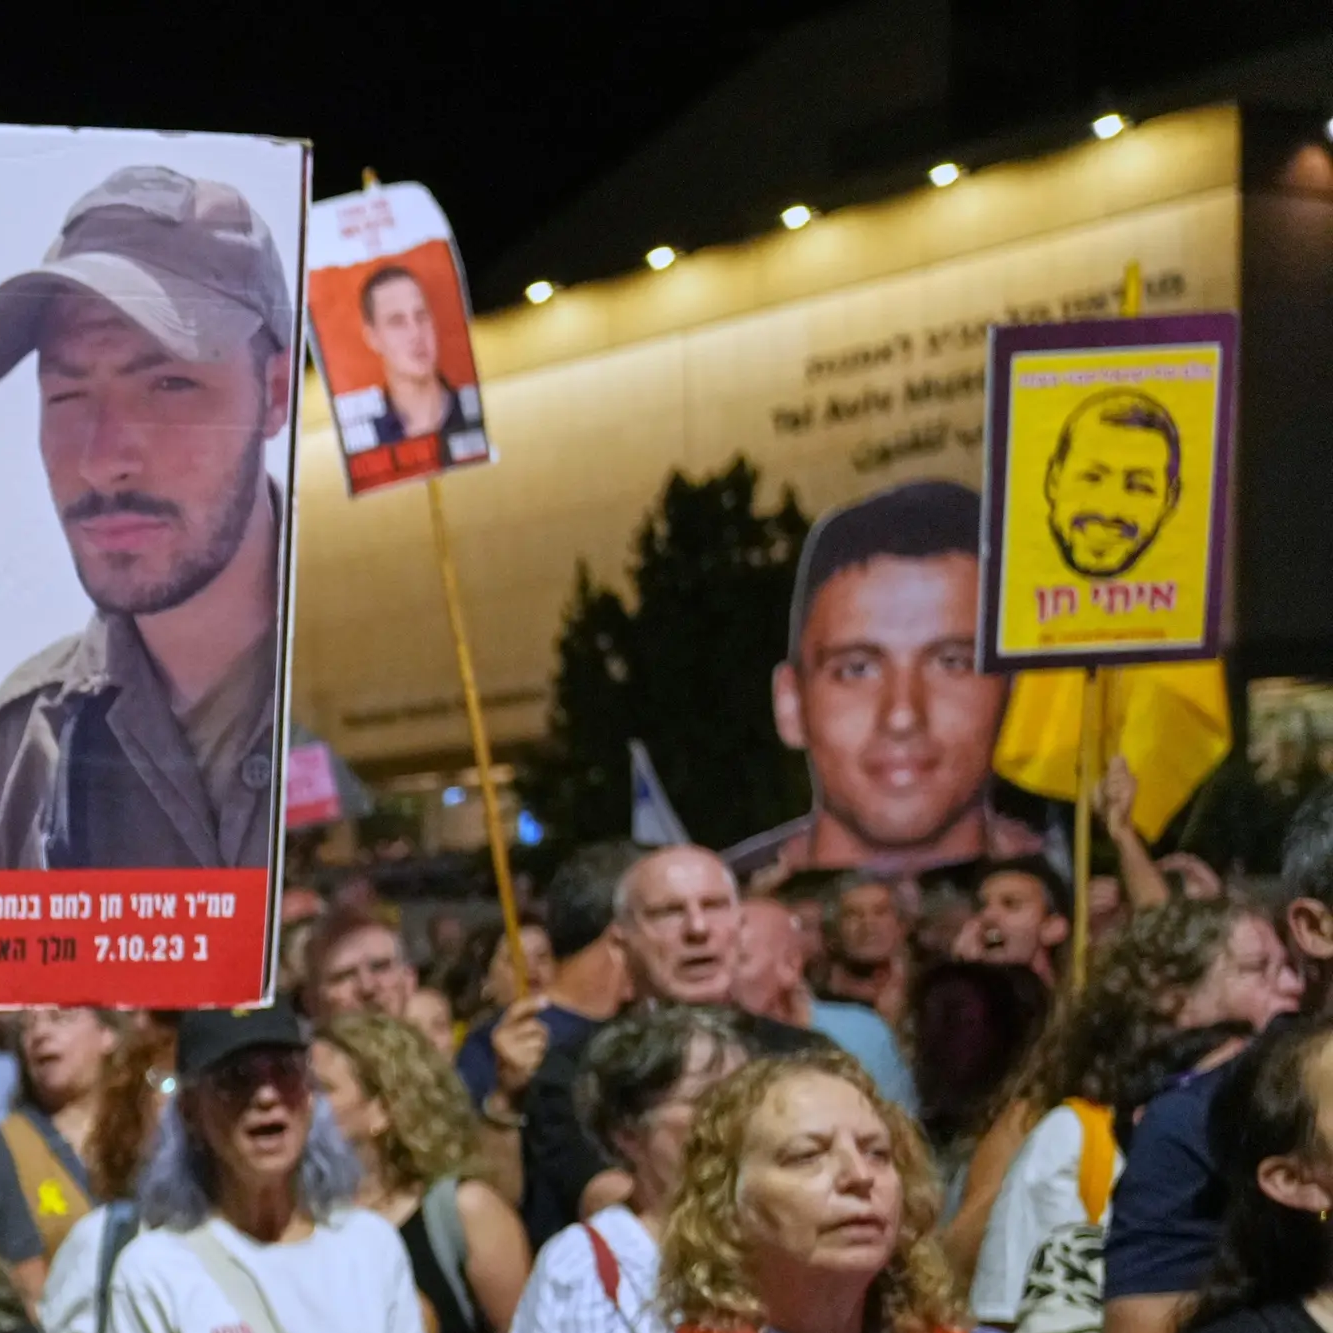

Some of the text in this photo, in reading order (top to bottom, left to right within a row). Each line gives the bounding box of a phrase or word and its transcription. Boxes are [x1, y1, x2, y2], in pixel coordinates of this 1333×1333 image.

[1035, 580, 1177, 625] איתי חן
[49, 891, 93, 920] לחם
[99, 893, 123, 923] חן
[130, 892, 177, 919] איתי
[184, 892, 237, 919] סמ"ר
[38, 936, 77, 965] מלך
[94, 934, 185, 963] 7.10.23
[192, 934, 209, 961] ב
